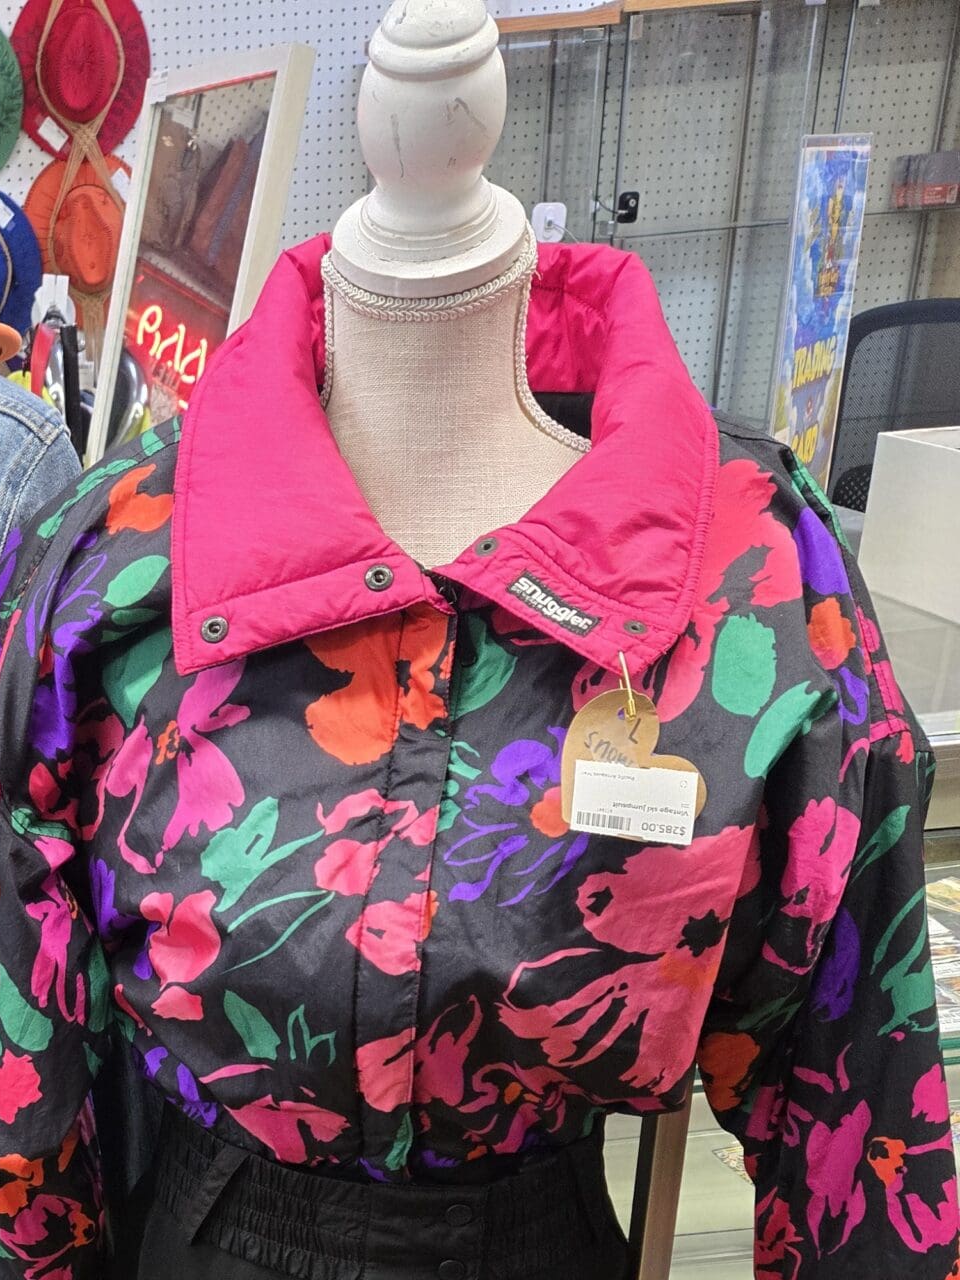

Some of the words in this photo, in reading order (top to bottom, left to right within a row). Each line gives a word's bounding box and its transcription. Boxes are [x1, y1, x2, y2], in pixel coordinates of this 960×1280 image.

[792, 333, 837, 389] TRADING
[659, 806, 689, 817] Vintage
[641, 821, 687, 836] $285.00
